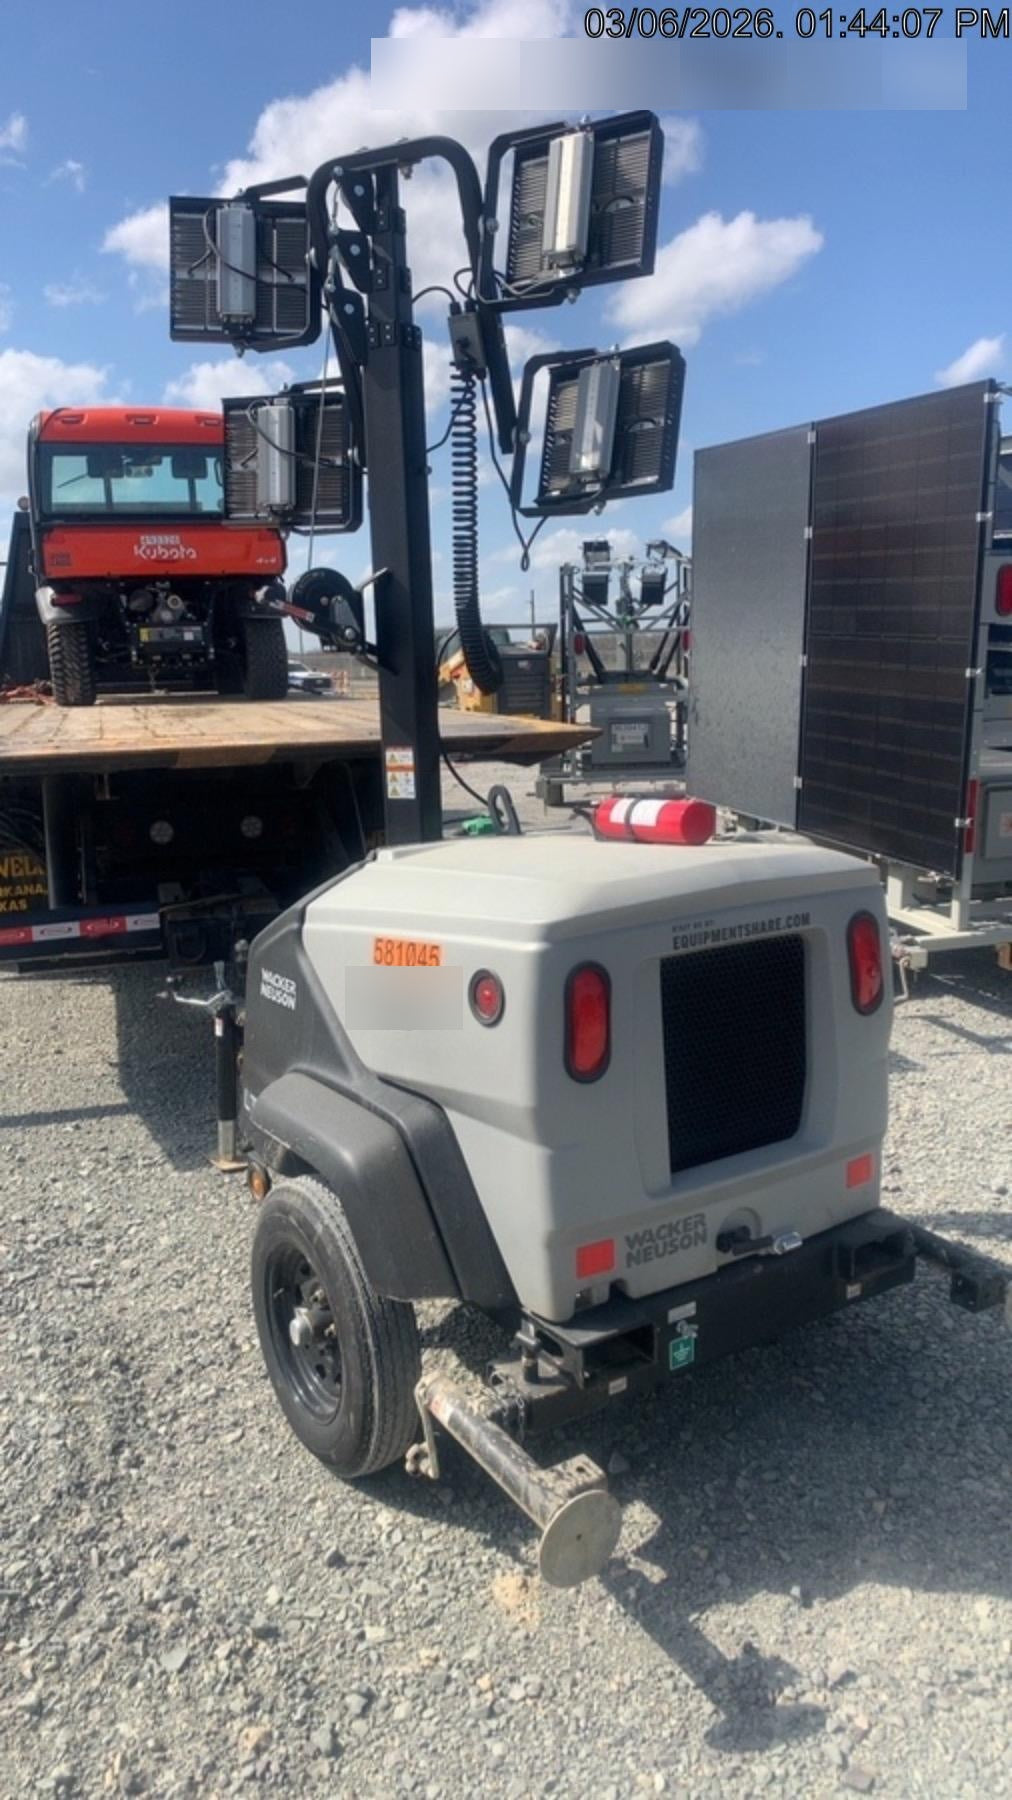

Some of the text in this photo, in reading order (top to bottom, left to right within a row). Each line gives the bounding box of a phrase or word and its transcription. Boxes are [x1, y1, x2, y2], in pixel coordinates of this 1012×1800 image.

[133, 543, 198, 560] Kubota
[673, 912, 811, 951] EQUIPMENTSHARE.COM
[373, 937, 441, 966] 581045
[261, 968, 297, 994] WACKER
[260, 982, 296, 1010] NEUSON
[624, 1213, 707, 1249] WACKER
[626, 1228, 708, 1268] NEUSON
